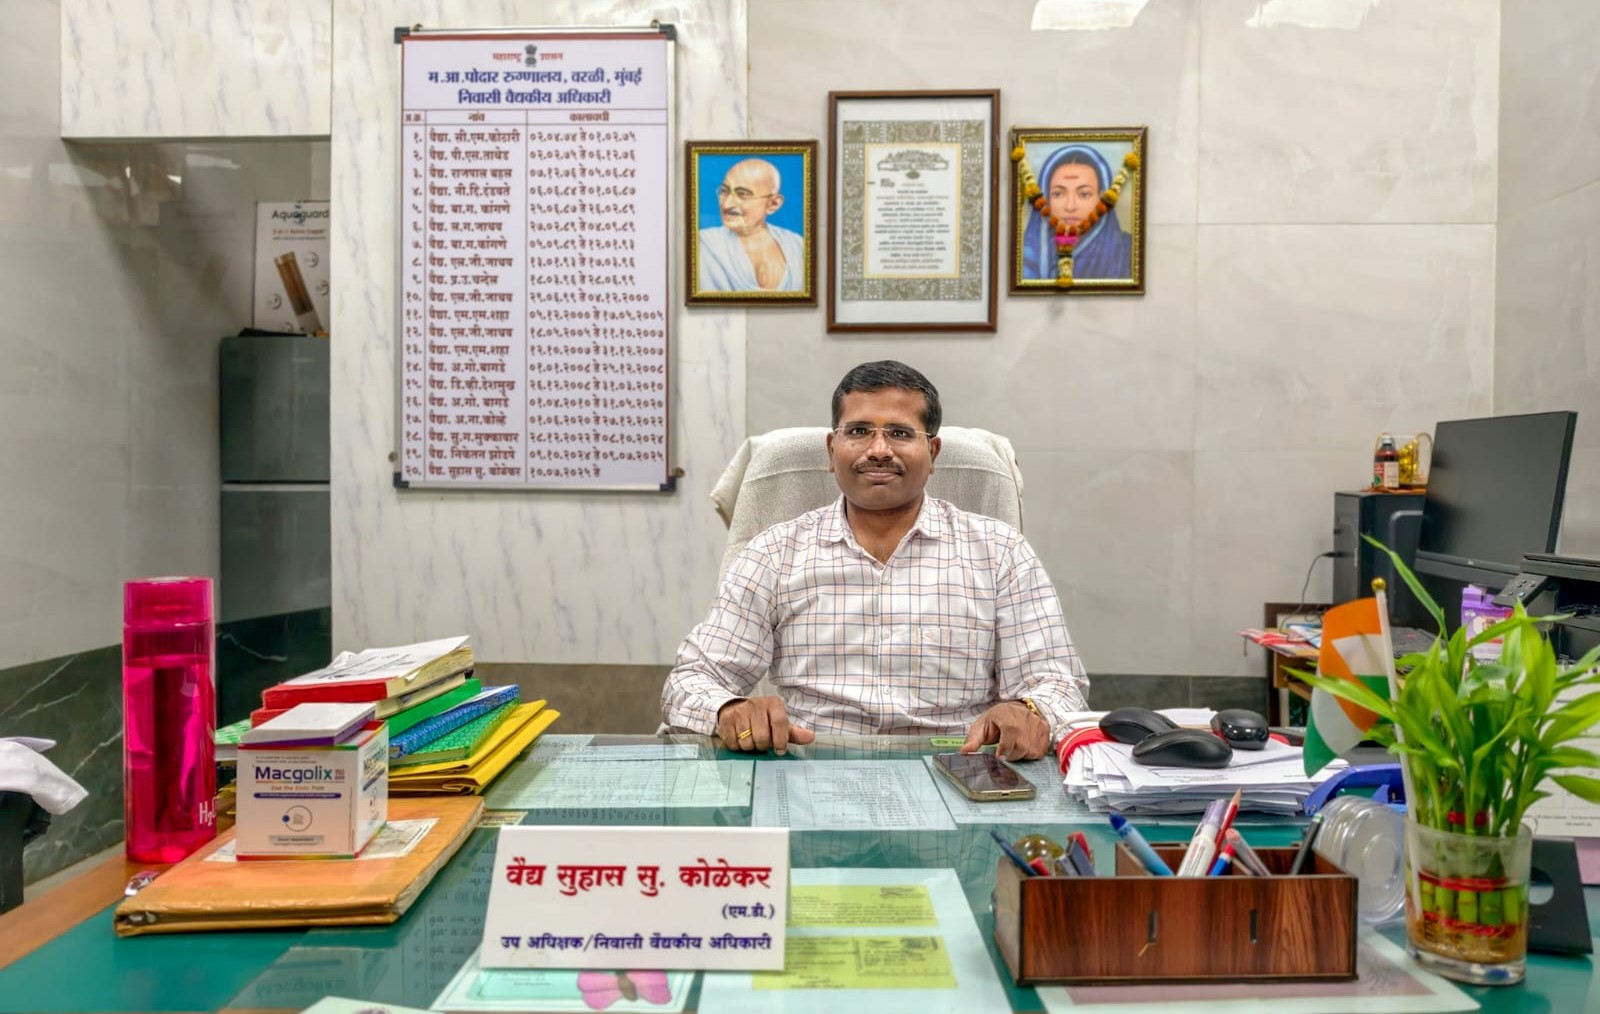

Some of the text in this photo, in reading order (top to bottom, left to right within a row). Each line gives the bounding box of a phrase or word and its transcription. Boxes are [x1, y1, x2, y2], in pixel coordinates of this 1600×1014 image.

[614, 67, 642, 87] मुंबई
[458, 89, 610, 103] निवासी वैद्यकीय अधिकारी
[448, 466, 473, 479] सुहास
[256, 766, 332, 784] Macgolix
[506, 857, 772, 896] वैद्य सुहास सु. कोळेकर
[501, 936, 521, 949] उप
[708, 933, 772, 949] अधिकारी
